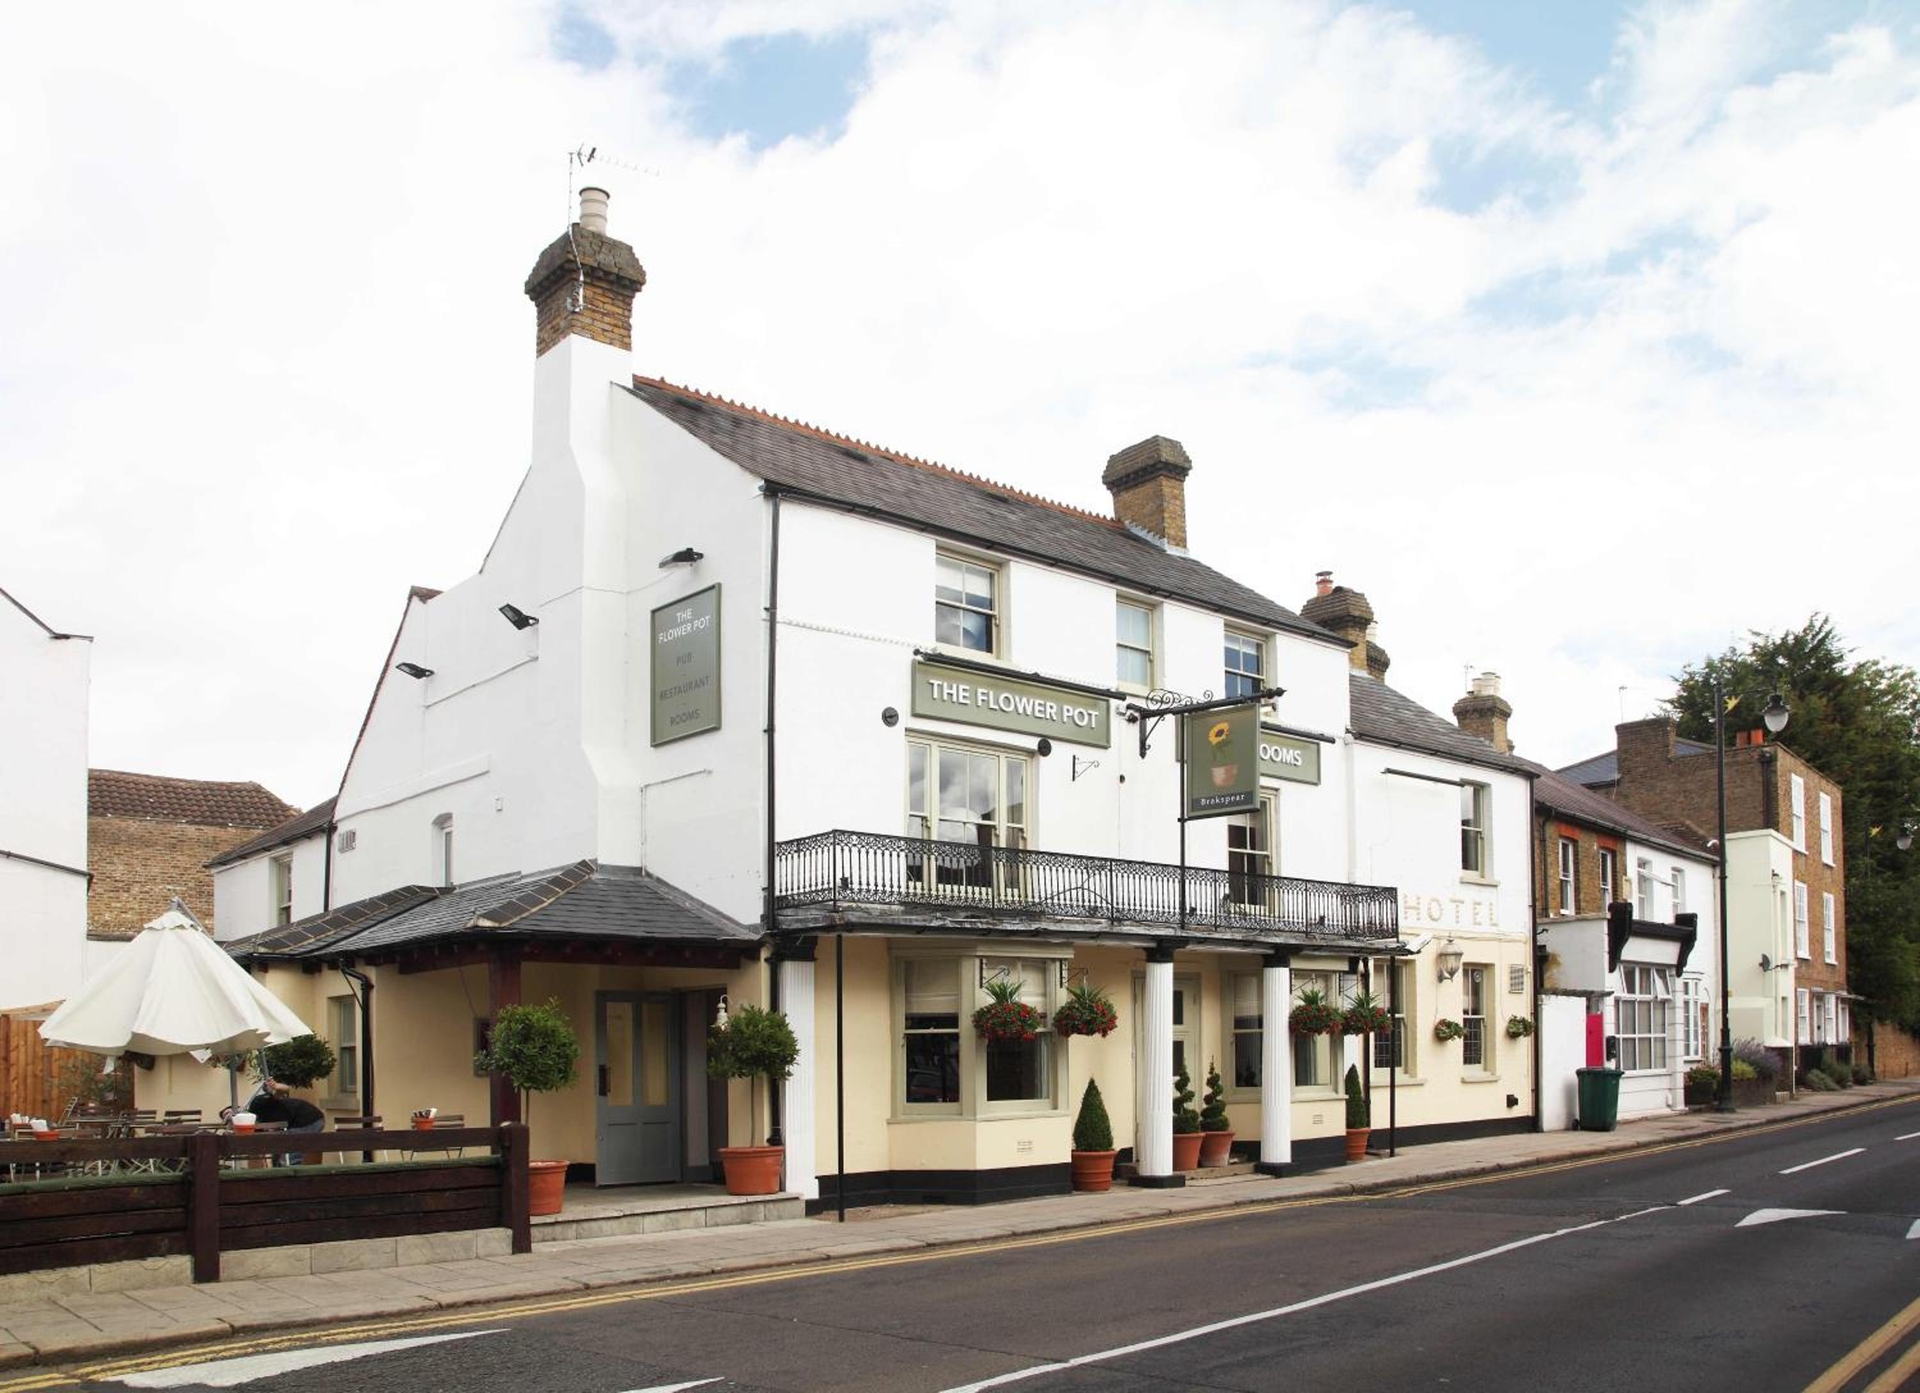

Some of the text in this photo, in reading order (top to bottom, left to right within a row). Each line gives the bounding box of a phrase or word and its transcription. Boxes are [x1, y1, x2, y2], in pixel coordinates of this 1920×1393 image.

[677, 608, 693, 623] THE
[658, 615, 711, 643] FLOWER POT
[676, 652, 693, 666] PUB
[659, 675, 710, 701] RESTAURANT
[929, 680, 1099, 729] THE FLOWER POT
[670, 708, 701, 727] ROOMS
[1259, 743, 1302, 766] OOMS
[1403, 893, 1499, 926] HOTEL
